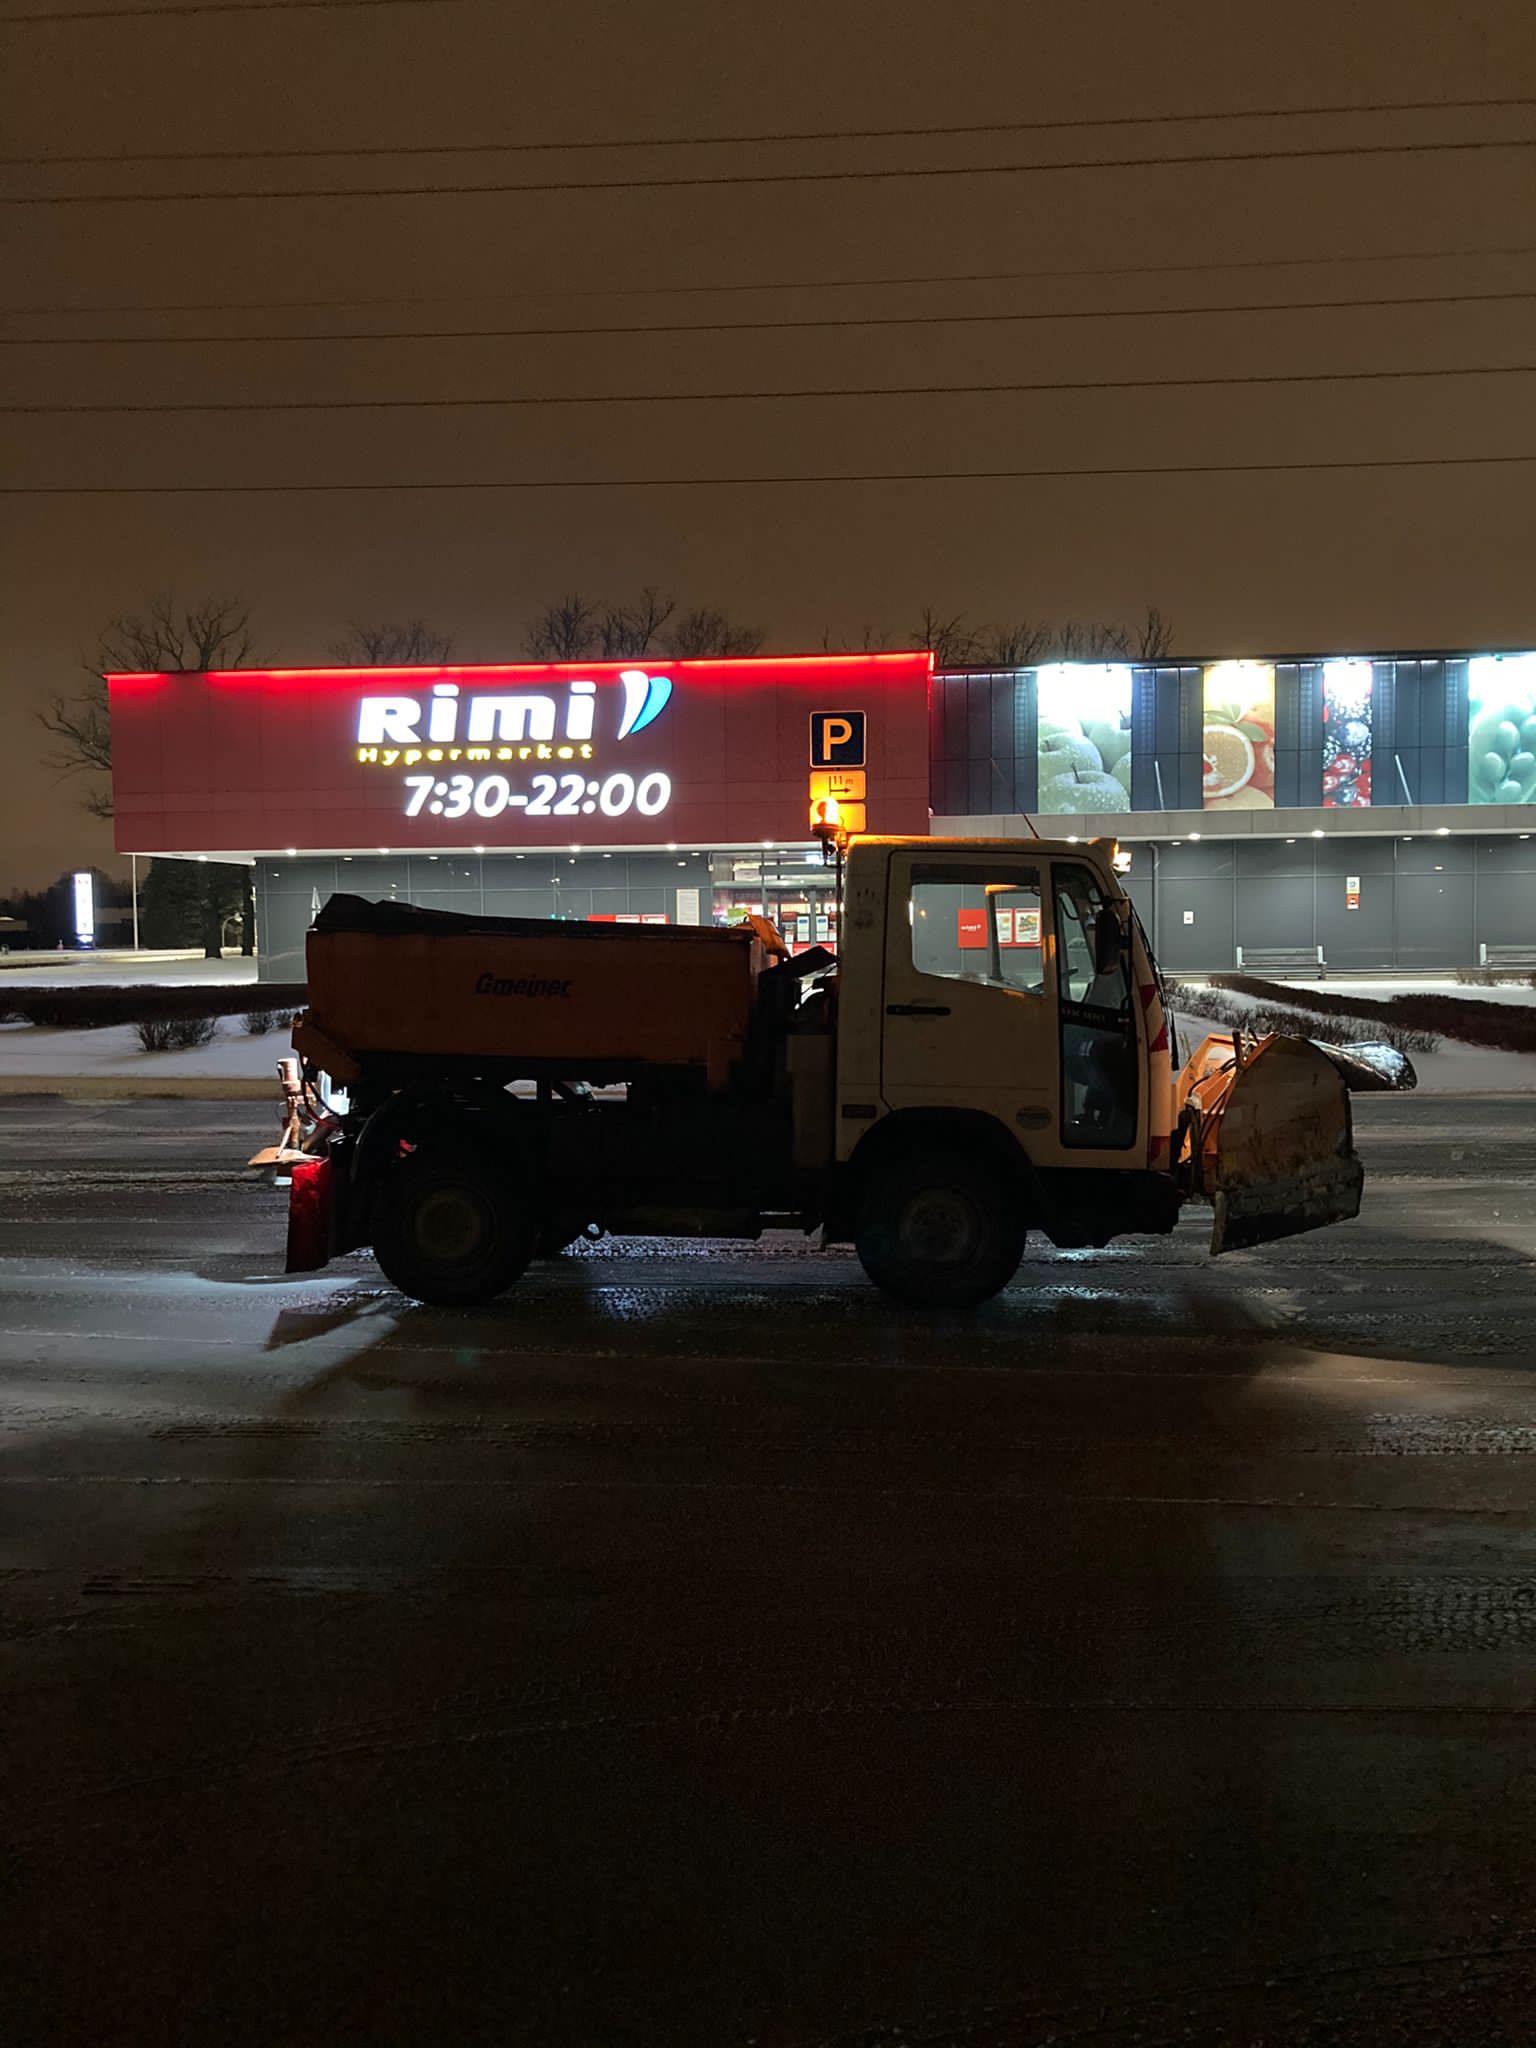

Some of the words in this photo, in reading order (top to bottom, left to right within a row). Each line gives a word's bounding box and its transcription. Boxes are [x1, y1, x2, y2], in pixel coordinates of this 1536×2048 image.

[358, 681, 597, 743] Rimi
[357, 743, 593, 766] Hypermarket
[823, 718, 852, 760] P
[404, 772, 671, 818] 7:30-22:00
[475, 972, 574, 998] Gmeiner
